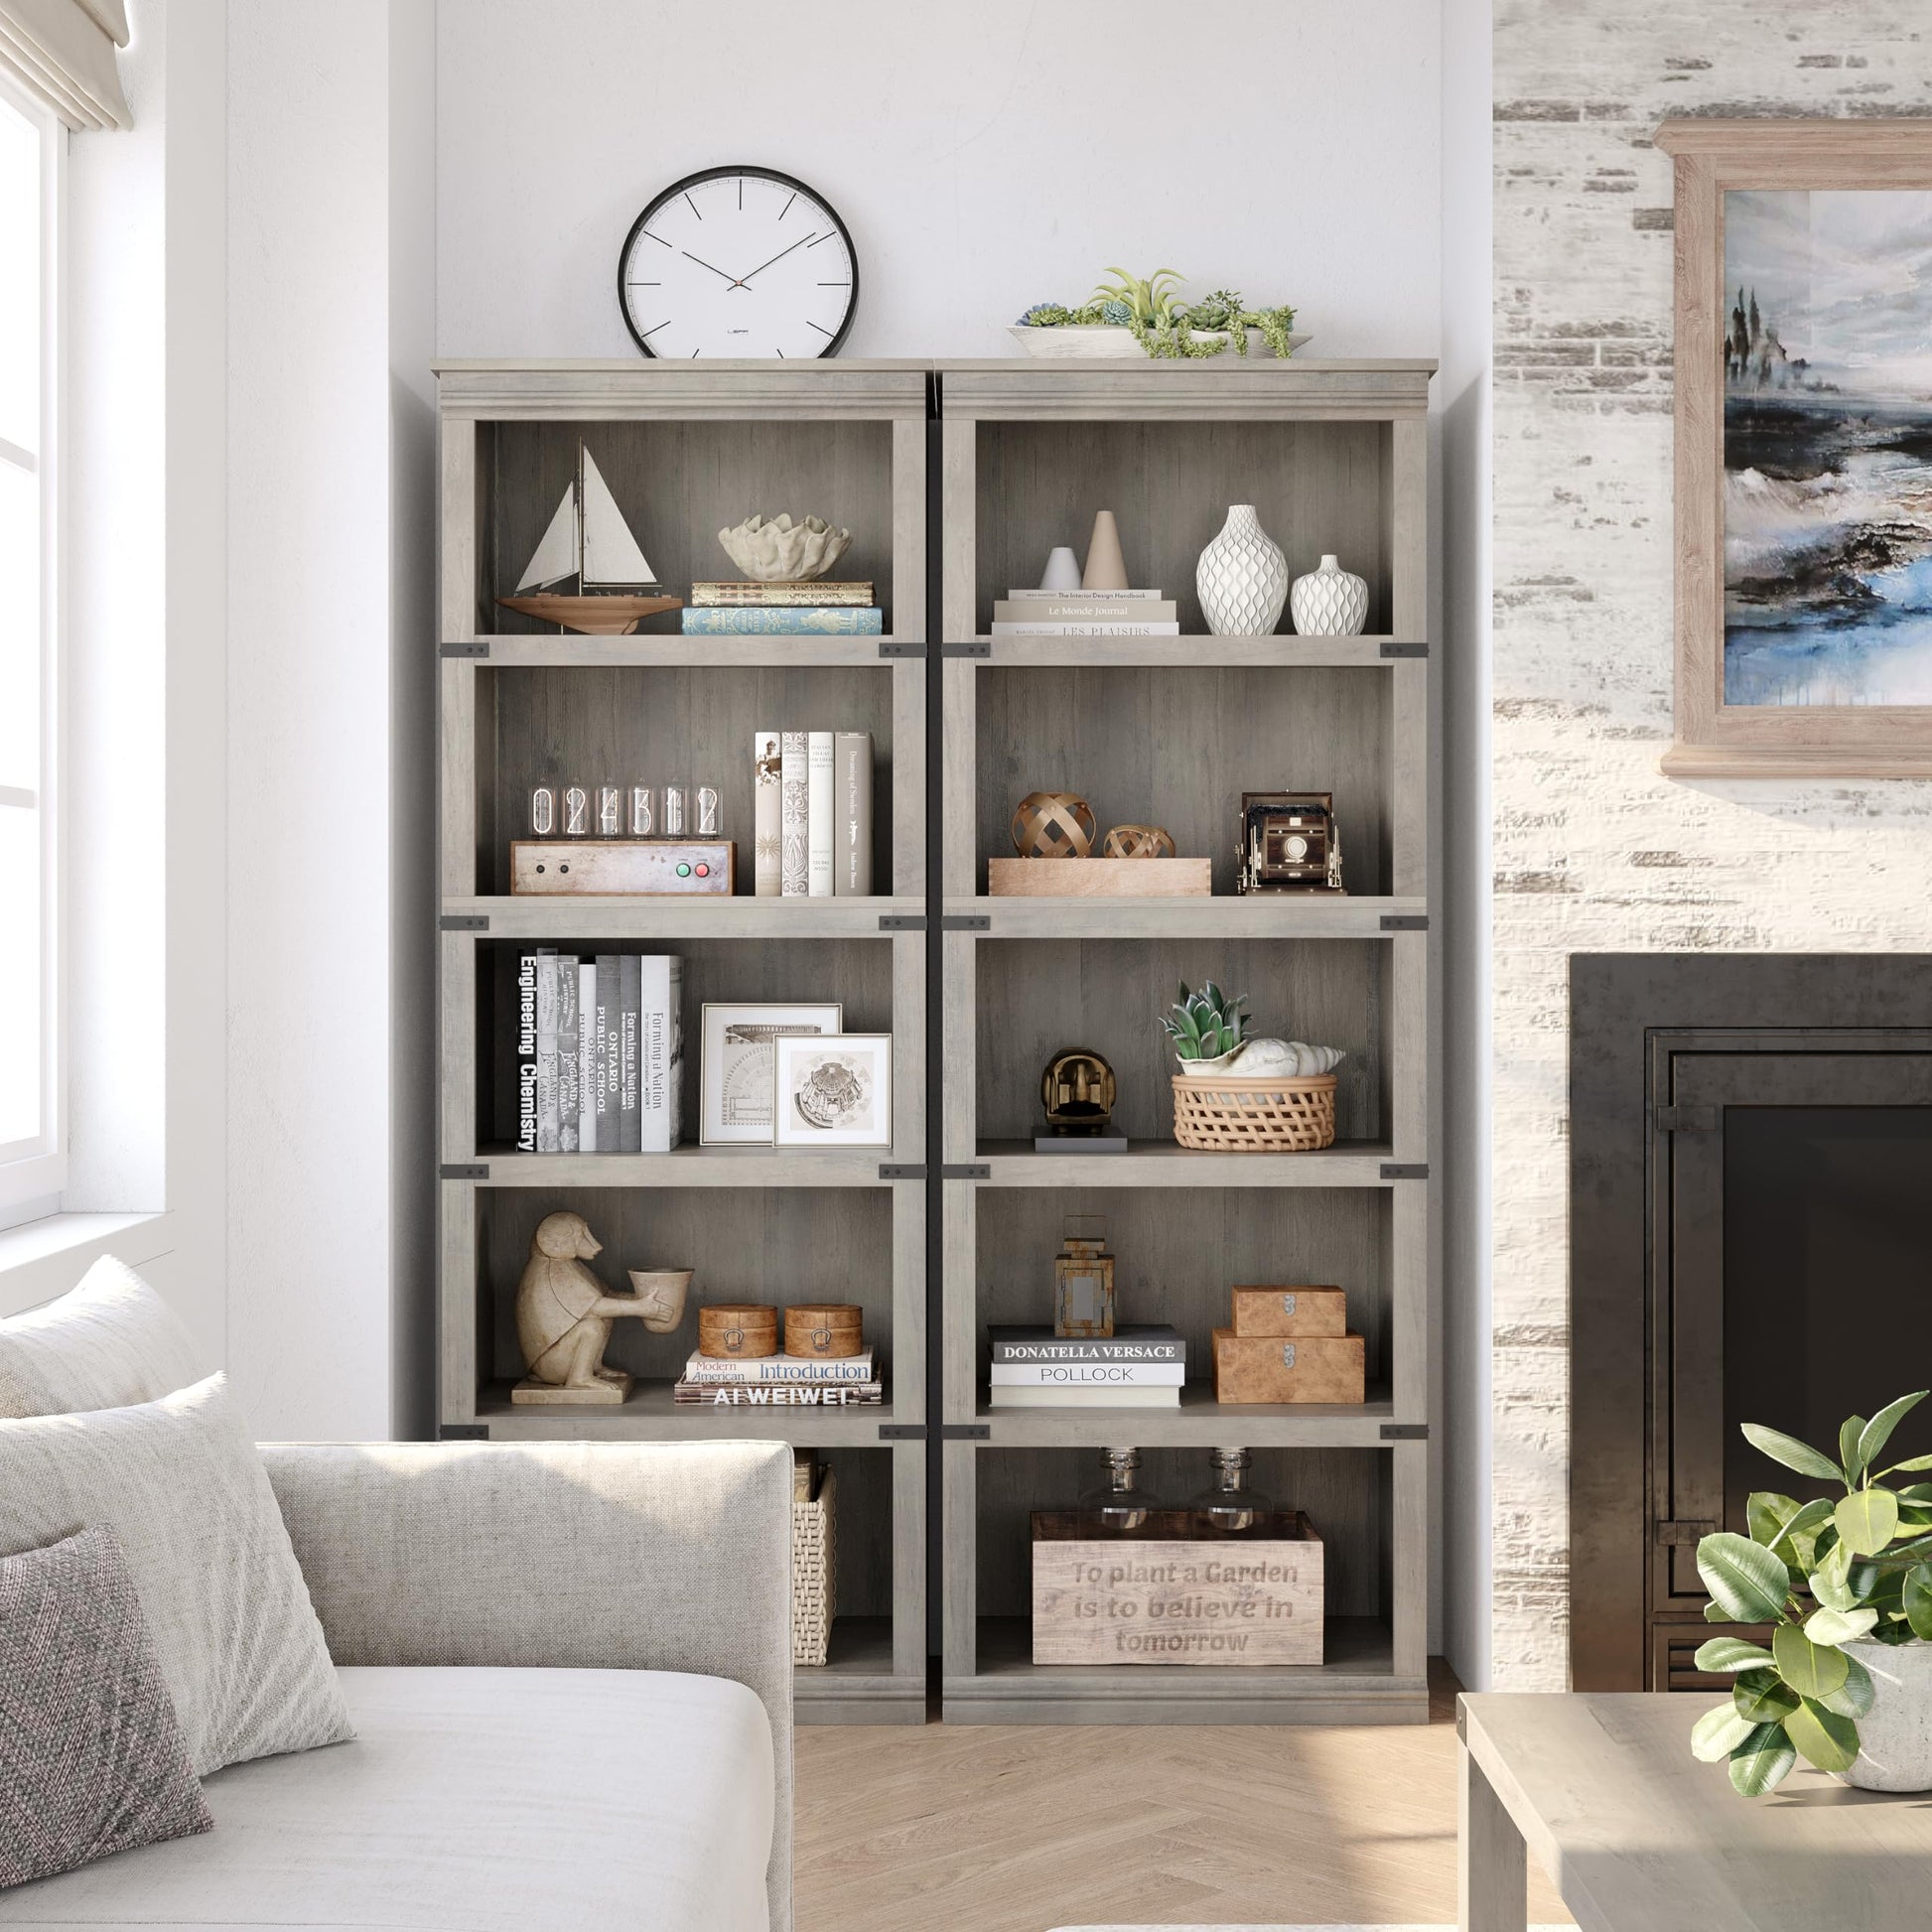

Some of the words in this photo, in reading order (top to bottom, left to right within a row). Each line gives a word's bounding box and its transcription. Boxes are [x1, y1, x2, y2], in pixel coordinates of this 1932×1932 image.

[1048, 607, 1059, 616] Le
[1061, 607, 1092, 616] Monde
[1094, 607, 1128, 617] Journal
[847, 751, 858, 782] Dreaming
[849, 789, 858, 815] Sweden
[566, 971, 575, 998] PUBLIC
[518, 956, 536, 1055] Engineering
[565, 999, 576, 1029] SCHOOL
[597, 1006, 606, 1054] PUBLIC
[626, 1012, 636, 1060] Forming
[651, 1013, 664, 1060] Forming
[609, 1032, 619, 1093] ONTARIO
[597, 1062, 606, 1115] SCHOOL
[626, 1072, 637, 1110] Nation
[652, 1072, 664, 1110] Nation
[517, 1063, 536, 1152] Chemistry
[1004, 1345, 1101, 1359] DONATELLA
[1102, 1345, 1175, 1359] VERSACE
[692, 1372, 745, 1382] American
[696, 1361, 737, 1371] Modern
[759, 1362, 869, 1380] Introduction
[1040, 1368, 1135, 1382] POLLOCK
[713, 1388, 739, 1405] AI
[747, 1387, 847, 1405] WEIWEI
[1071, 1562, 1103, 1584] To
[1109, 1562, 1176, 1588] plant
[1183, 1566, 1198, 1584] a
[1205, 1561, 1299, 1584] Garden
[1074, 1596, 1098, 1618] is
[1107, 1597, 1138, 1618] to
[1147, 1596, 1257, 1618] believe
[1264, 1595, 1294, 1618] in
[1115, 1629, 1250, 1652] tomorrow
